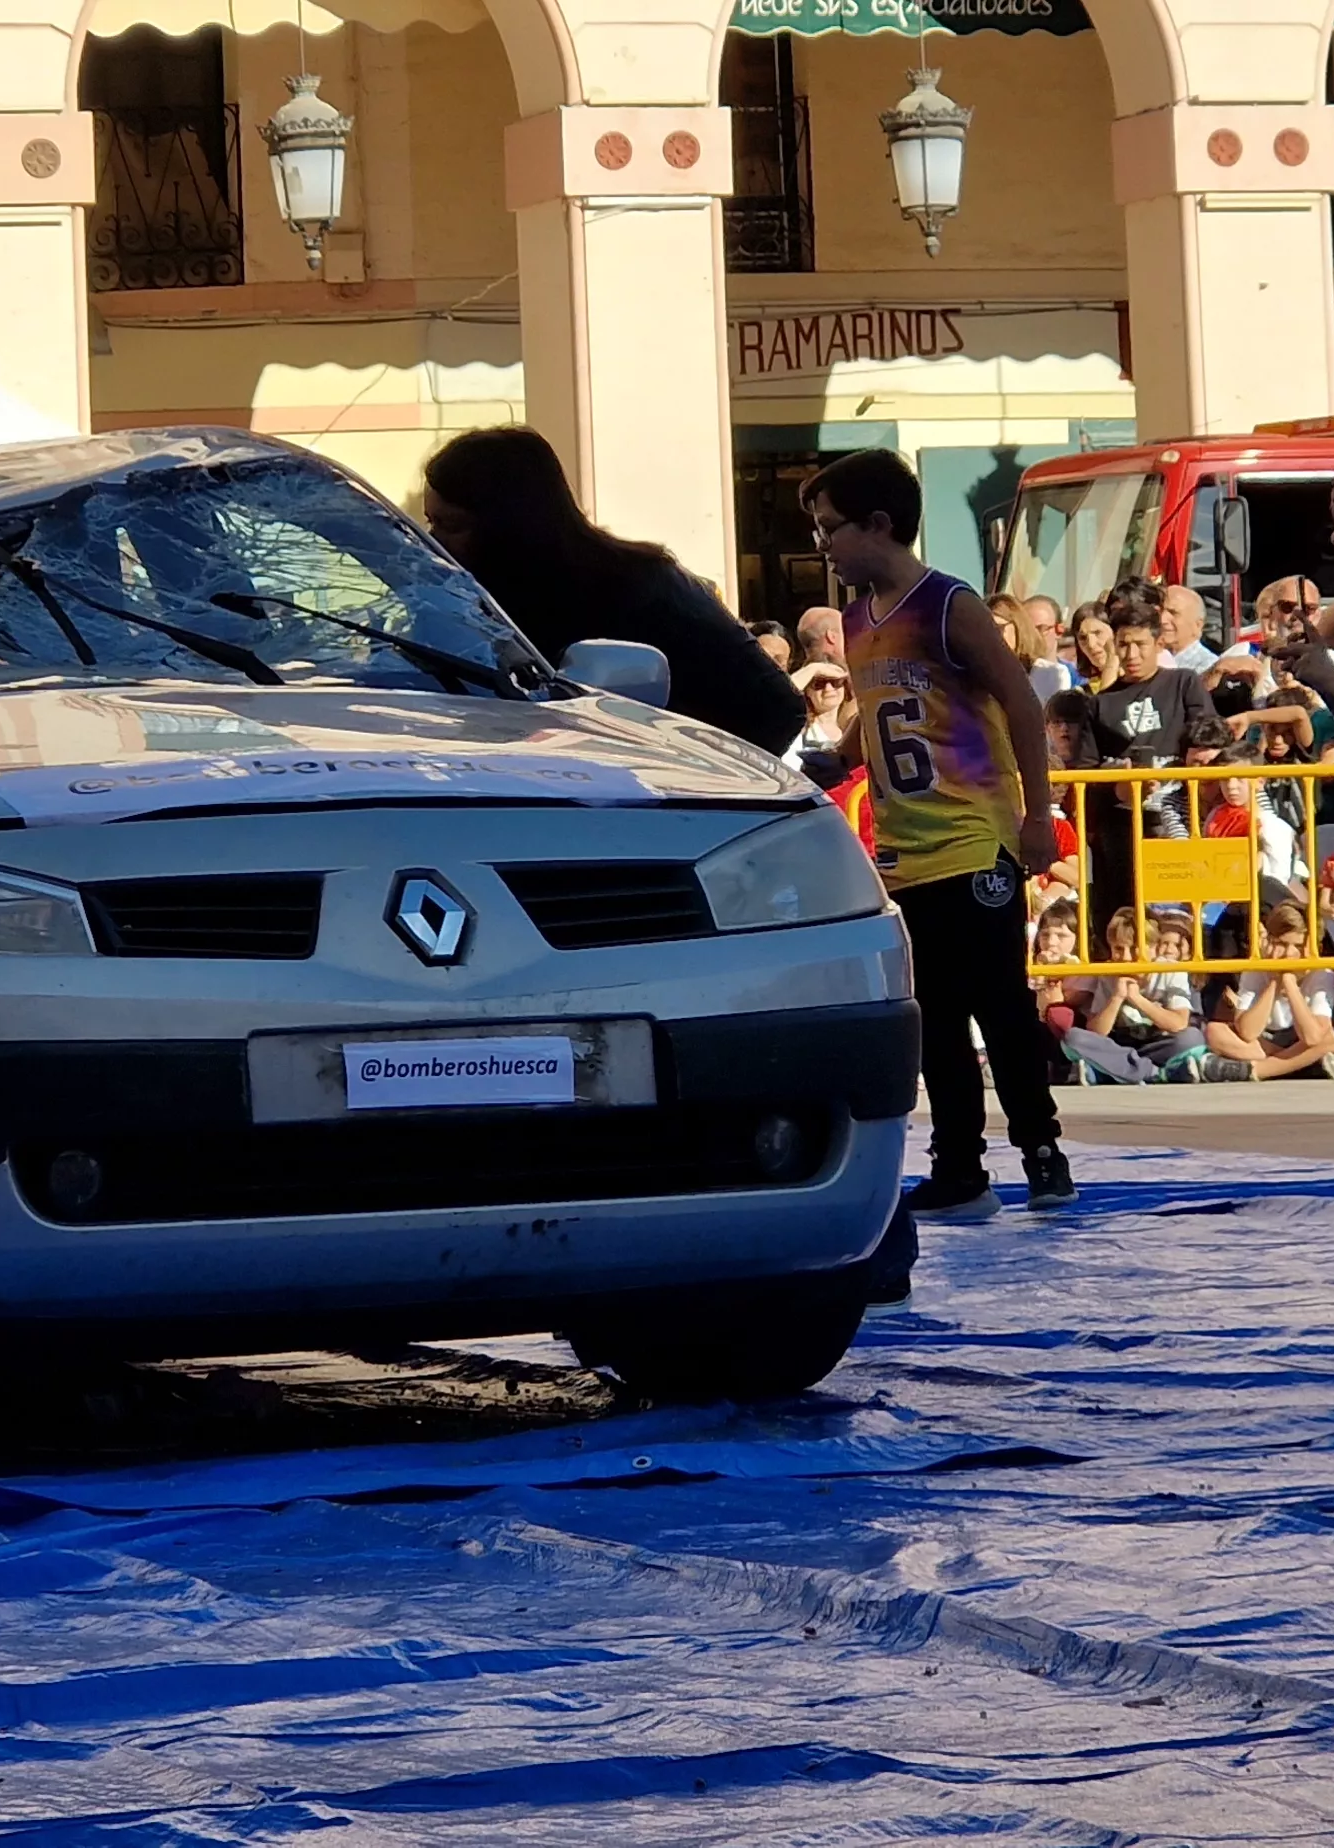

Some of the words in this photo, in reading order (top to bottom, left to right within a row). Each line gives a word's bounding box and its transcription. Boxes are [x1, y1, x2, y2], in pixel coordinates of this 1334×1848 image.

[729, 308, 965, 375] RAMARINOS
[68, 757, 593, 796] @boberosueca
[360, 1055, 559, 1083] @bomberoshuesca
